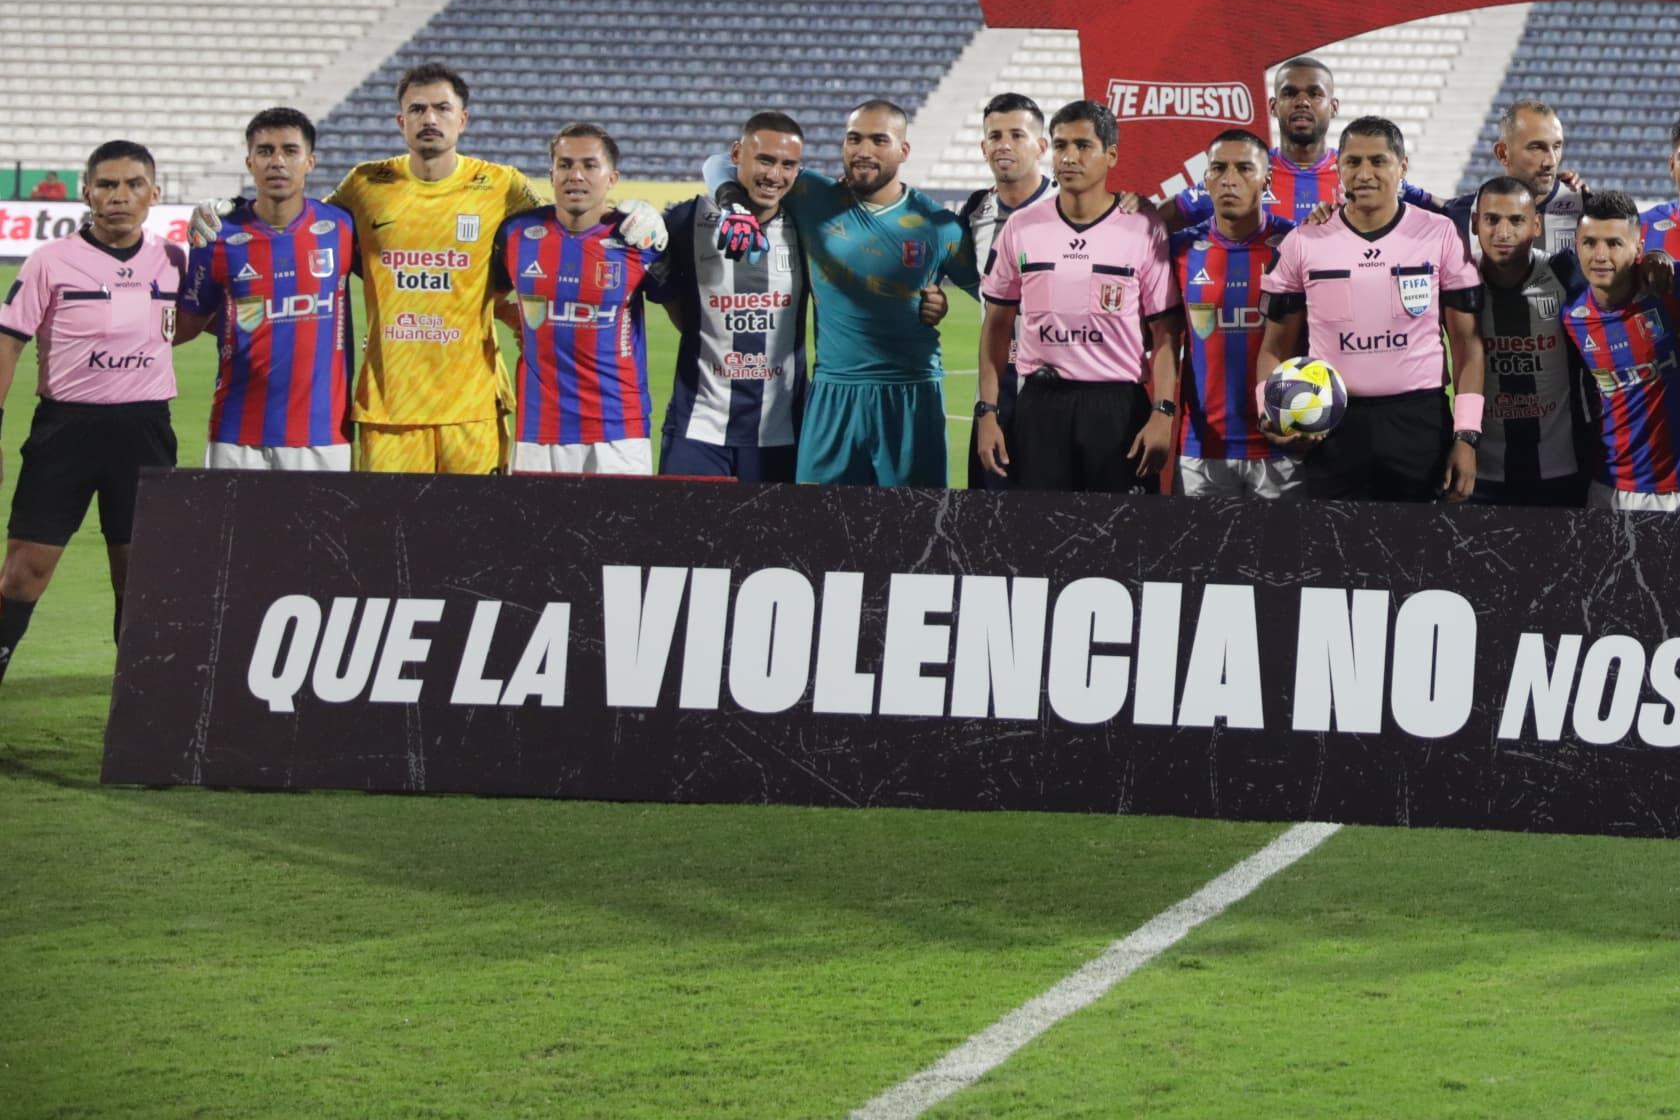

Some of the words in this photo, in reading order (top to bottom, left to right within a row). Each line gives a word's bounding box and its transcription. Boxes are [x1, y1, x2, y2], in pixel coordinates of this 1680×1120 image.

[1111, 84, 1140, 117] TE
[1141, 86, 1249, 120] APUESTO
[381, 249, 469, 269] apuesta
[396, 271, 451, 290] total
[1402, 277, 1428, 289] FIFA
[265, 292, 334, 320] UDH
[709, 290, 792, 312] apuesta
[547, 300, 618, 323] UDH
[1217, 307, 1264, 328] UD
[418, 316, 443, 327] Caja
[724, 313, 775, 331] total
[384, 326, 460, 343] Huancayo
[1039, 325, 1104, 344] Kuria
[1339, 330, 1408, 350] Kuria
[1484, 334, 1556, 353] puesta
[745, 354, 768, 368] Caja
[1489, 355, 1544, 374] total
[713, 363, 783, 381] Huancayo
[247, 594, 446, 713] QUE
[450, 599, 573, 708] LA
[601, 564, 1265, 731] VIOLENCIA
[1292, 585, 1478, 740] NO
